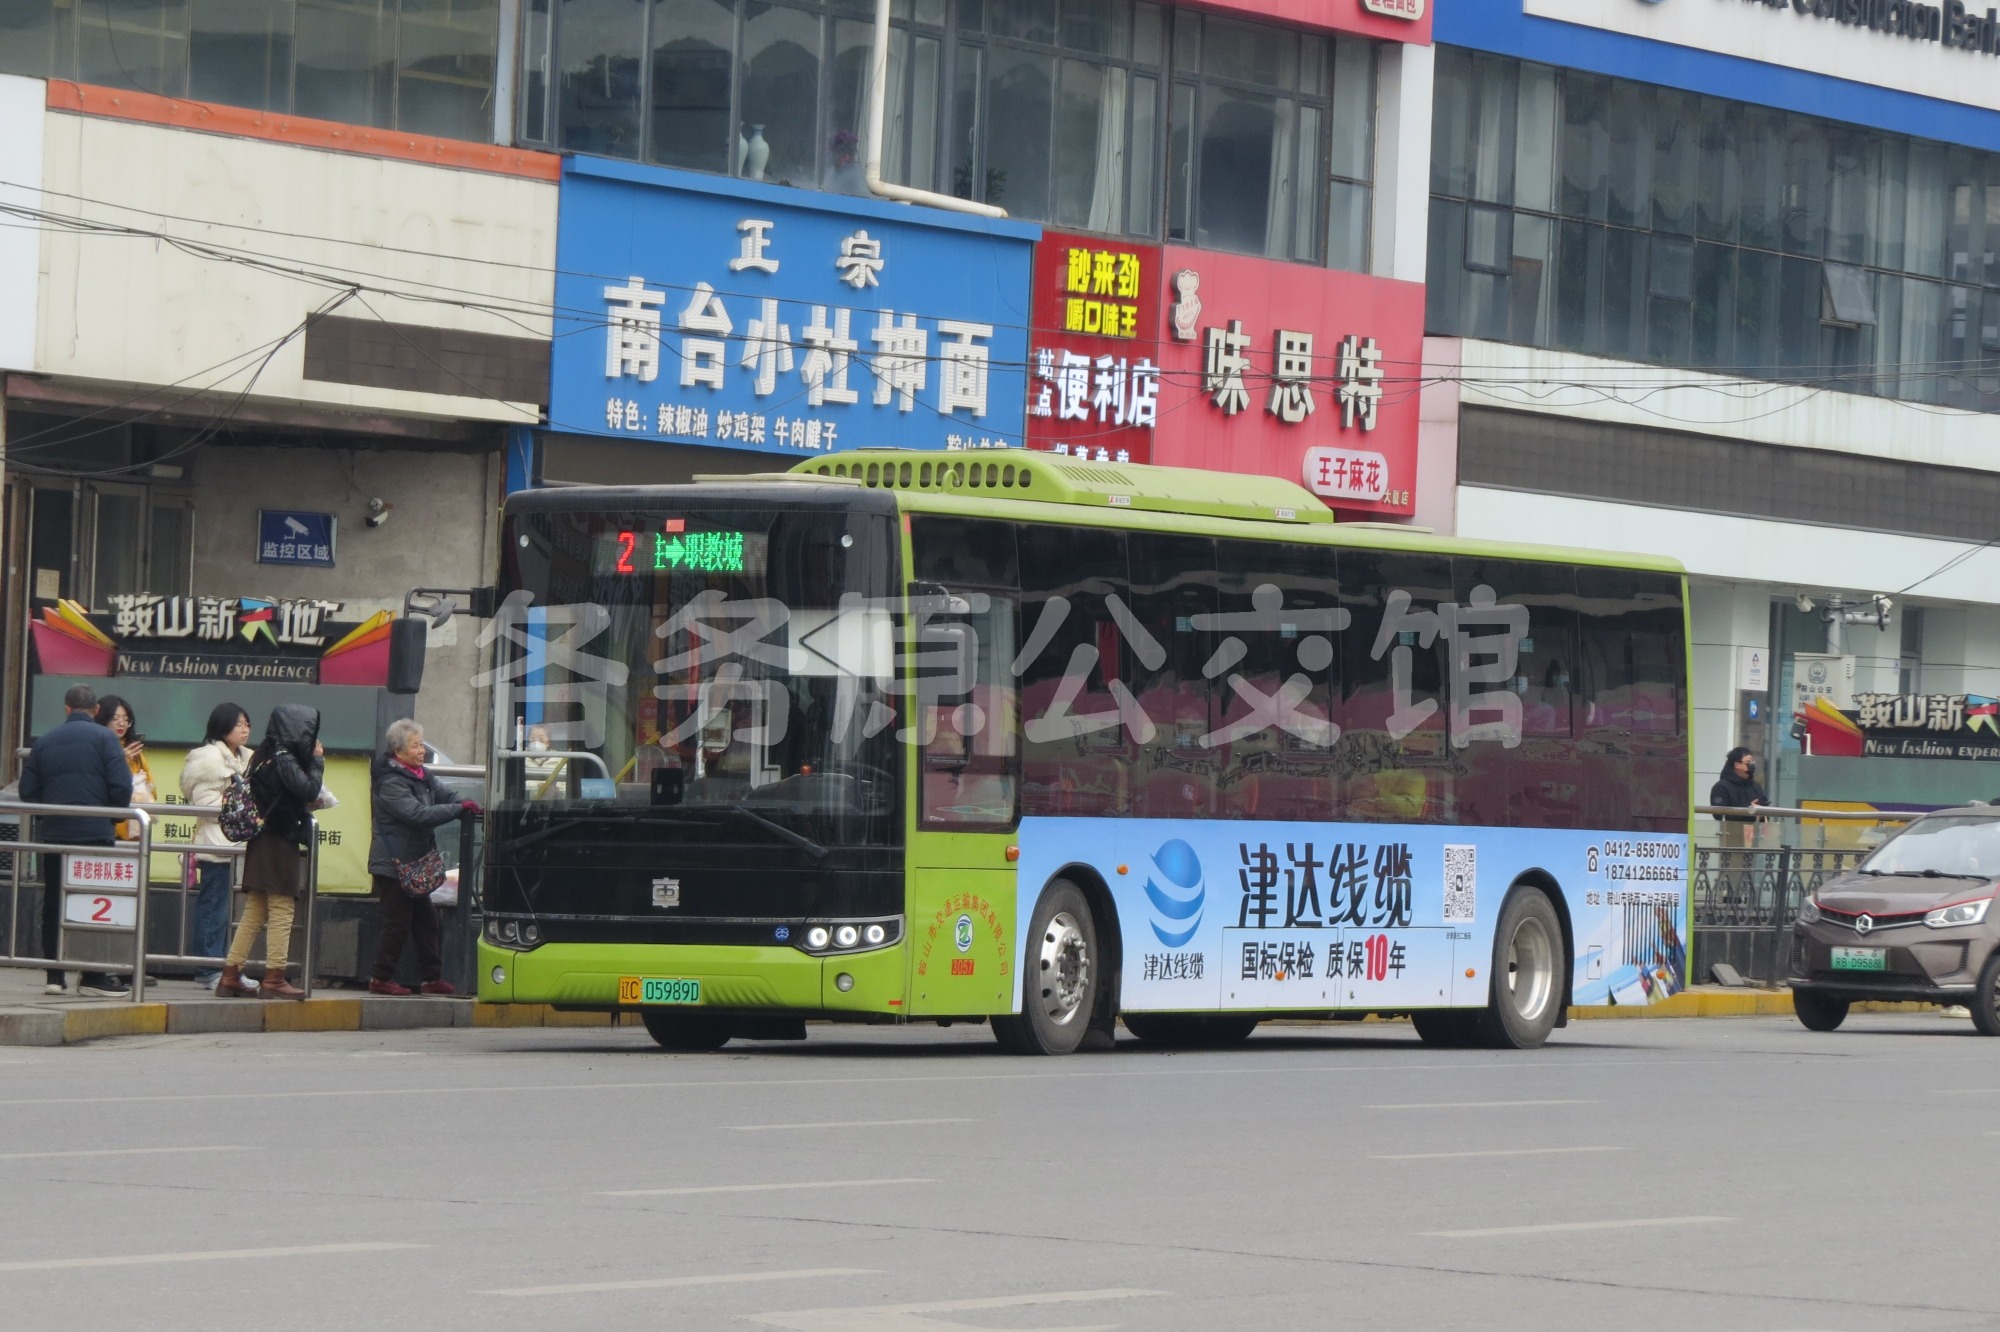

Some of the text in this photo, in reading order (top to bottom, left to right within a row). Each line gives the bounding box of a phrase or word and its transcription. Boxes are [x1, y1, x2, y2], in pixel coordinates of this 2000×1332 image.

[729, 218, 885, 288] 正宗
[1067, 248, 1140, 299] 秒来劲
[604, 276, 993, 417] 南台小杜抻面
[1037, 348, 1055, 417] 站点
[1057, 349, 1160, 428] 便利店
[1202, 319, 1384, 431] 味思特
[658, 403, 708, 438] 辣椒油
[716, 409, 766, 444] 炒鸡架
[774, 415, 838, 450] 牛肉腱子
[1317, 456, 1381, 493] 王子麻花
[262, 541, 330, 561] 监控区域
[617, 532, 635, 573] 2
[73, 860, 134, 881] 请您排队乘车
[1604, 840, 1681, 859] 0412-8587000
[1238, 842, 1413, 929] 津达线缆
[91, 897, 113, 922] 2
[952, 960, 974, 975] 3057
[1143, 952, 1205, 981] 津达线缆
[1241, 933, 1407, 982] 国标保检 质保10年
[621, 981, 699, 1001] 辽C 05989D
